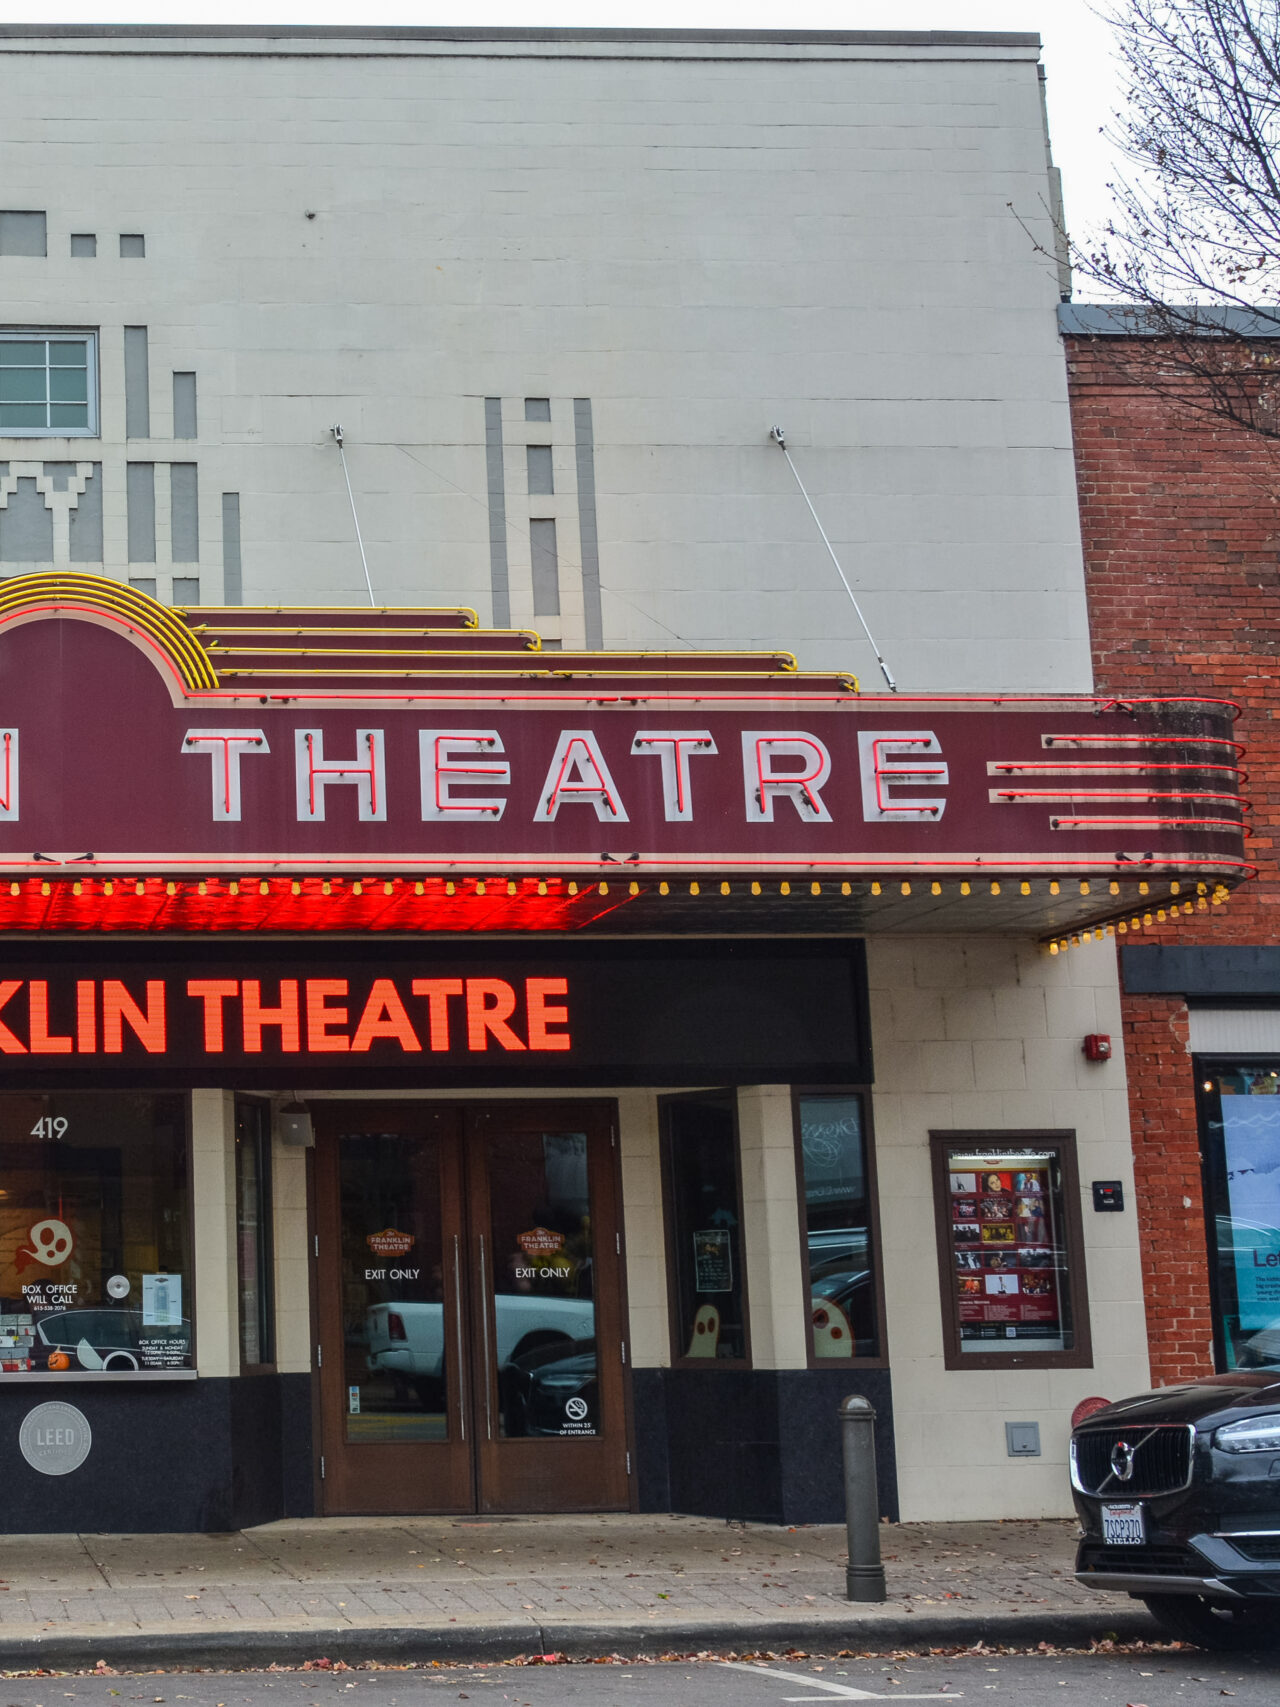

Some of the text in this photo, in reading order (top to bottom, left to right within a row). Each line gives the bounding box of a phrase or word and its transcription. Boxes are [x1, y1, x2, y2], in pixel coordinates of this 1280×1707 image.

[181, 728, 950, 823] THEATRE
[187, 978, 571, 1053] THEATRE
[30, 1117, 69, 1140] 419
[365, 1269, 420, 1280] EXIT ONLY
[515, 1267, 570, 1278] EXIT ONLY
[21, 1284, 78, 1294] BOX OFFICE
[26, 1294, 74, 1304] WILL CALL
[37, 1428, 75, 1446] LEED
[1104, 1519, 1142, 1538] 7SCP370
[1106, 1537, 1141, 1545] NIELLO
